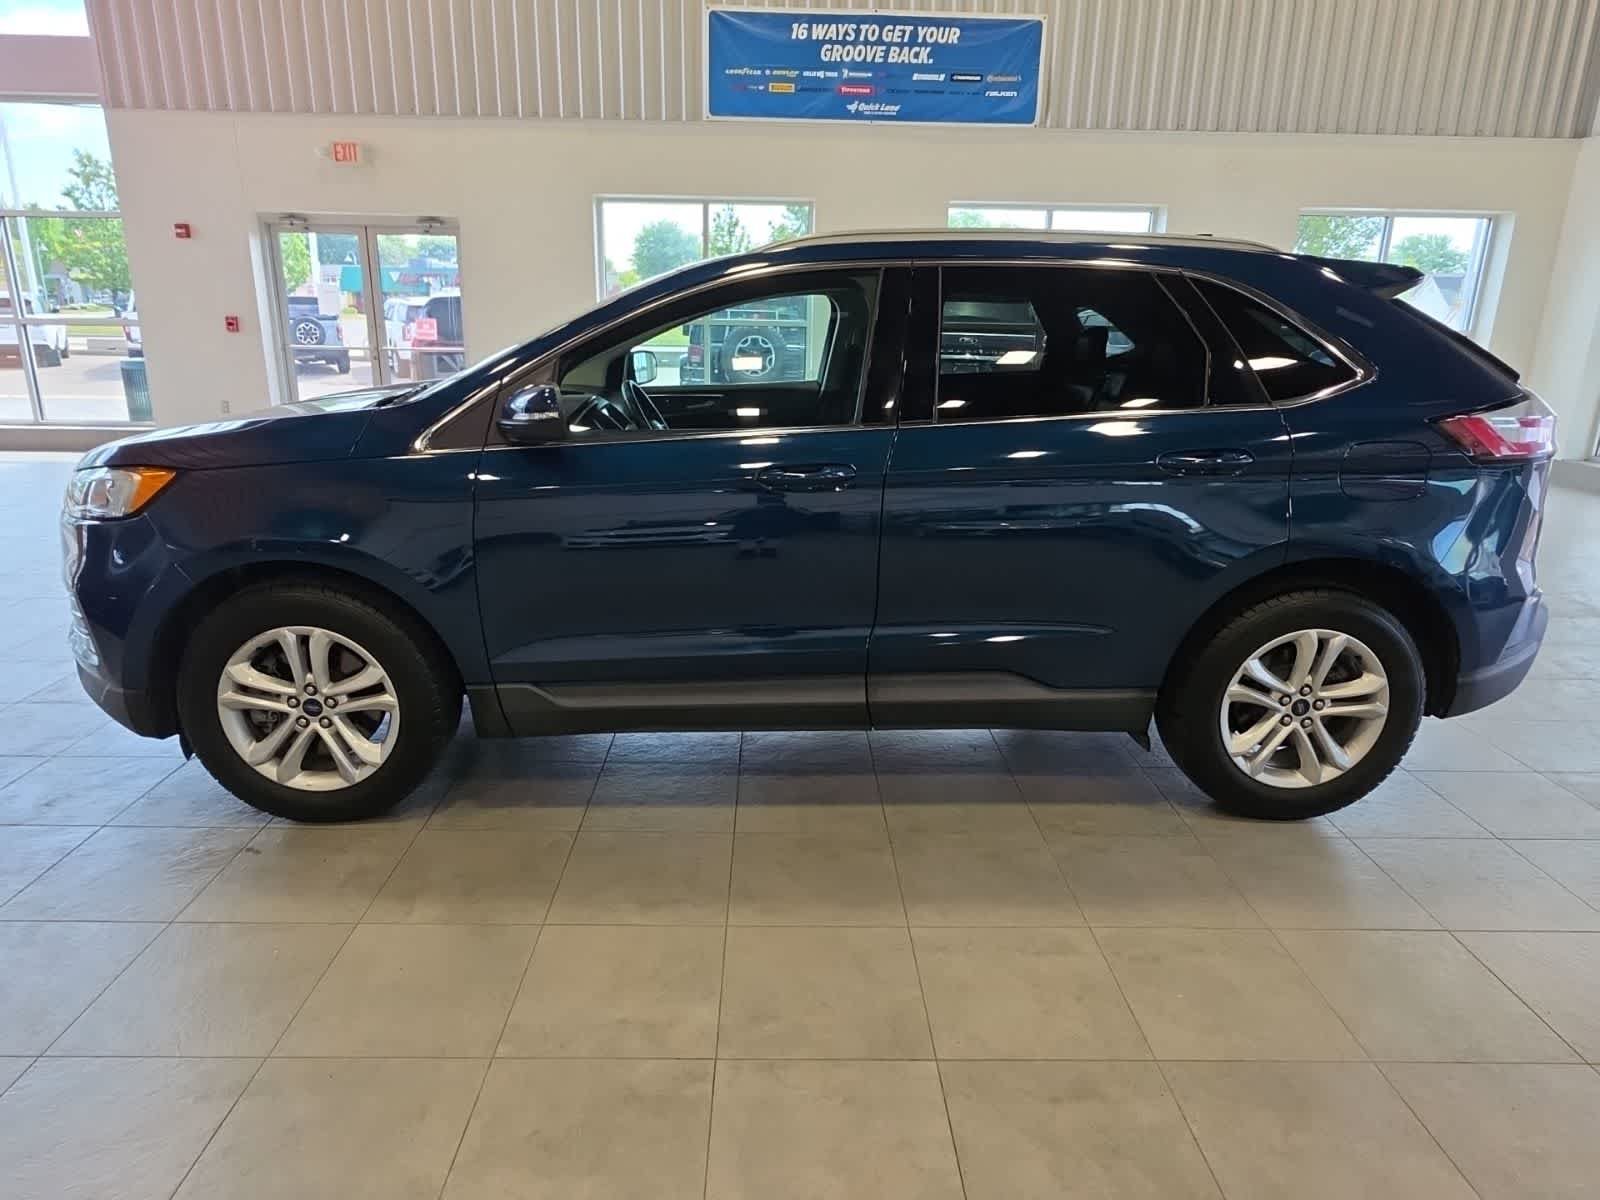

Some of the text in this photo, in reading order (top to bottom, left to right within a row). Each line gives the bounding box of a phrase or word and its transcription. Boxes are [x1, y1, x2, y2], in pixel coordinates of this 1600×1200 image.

[791, 23, 961, 44] 16 WAYS TO GET YOUR
[820, 44, 933, 64] GROOVE BACK.
[334, 143, 357, 162] EXIT
